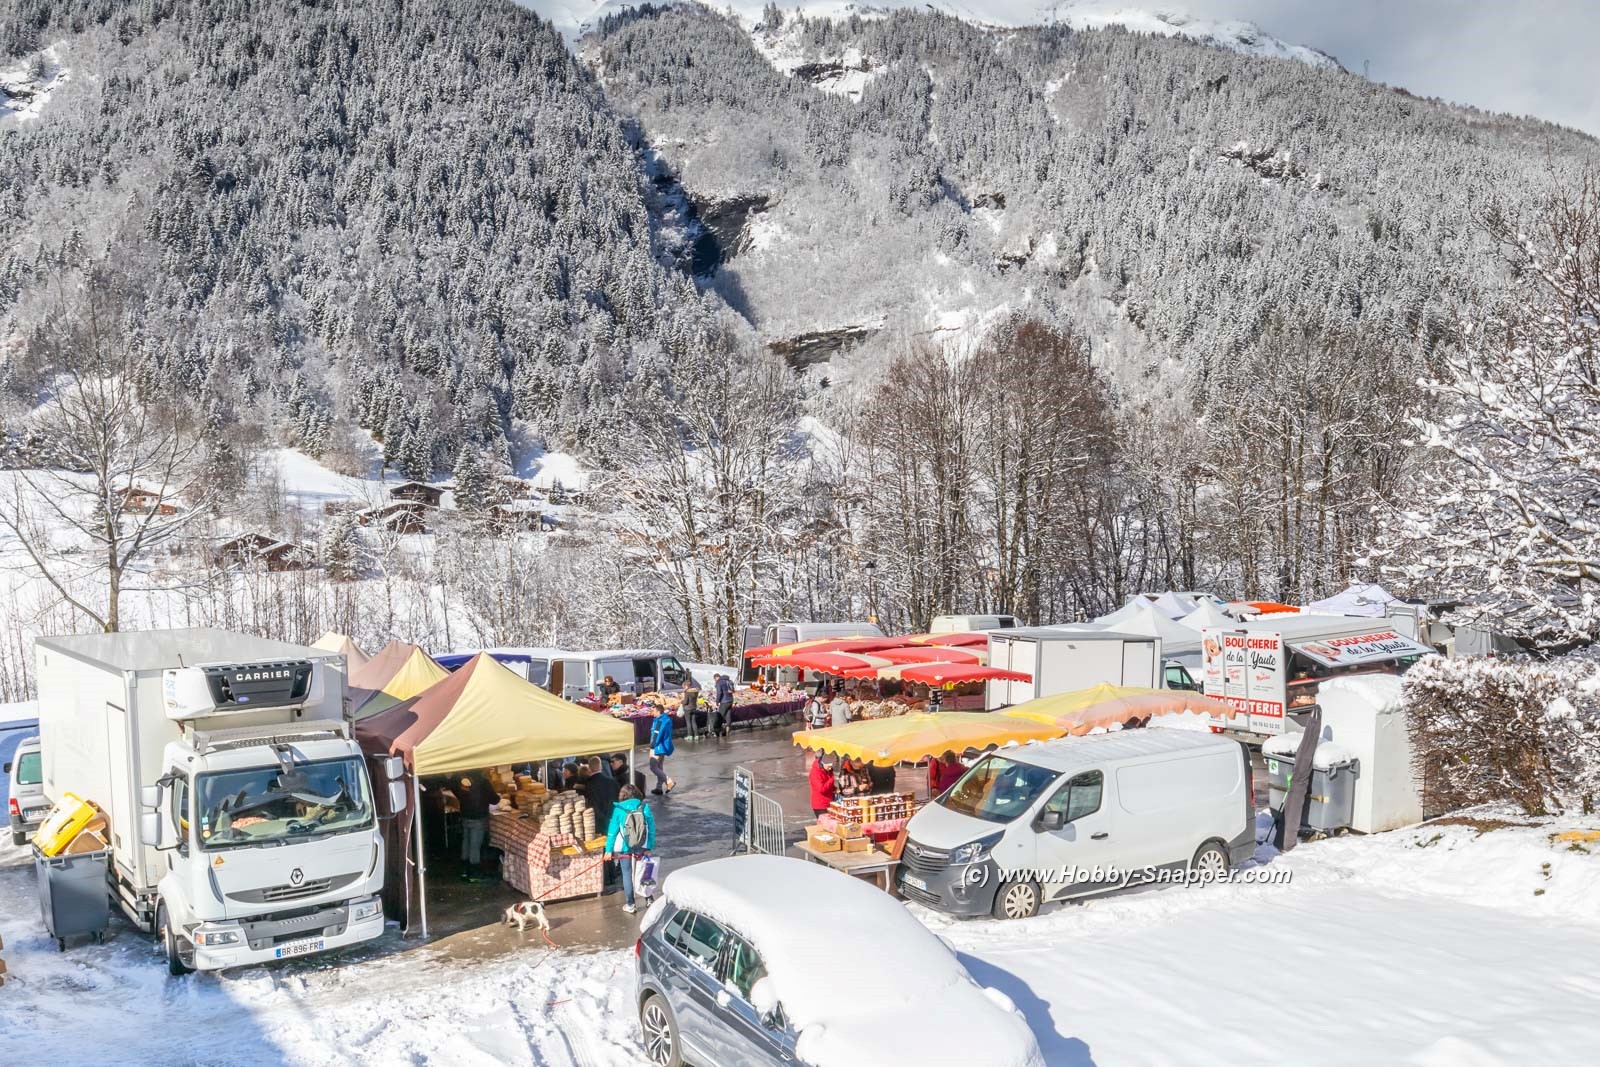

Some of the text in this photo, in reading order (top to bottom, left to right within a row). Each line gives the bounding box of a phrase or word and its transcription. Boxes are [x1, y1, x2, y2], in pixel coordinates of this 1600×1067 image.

[1225, 637, 1278, 650] BOUCHERIE
[1327, 632, 1398, 647] BOUCHERIE
[1346, 639, 1410, 655] de la Yaute
[1226, 650, 1276, 669] de la Yaute
[235, 670, 291, 681] CARRIER
